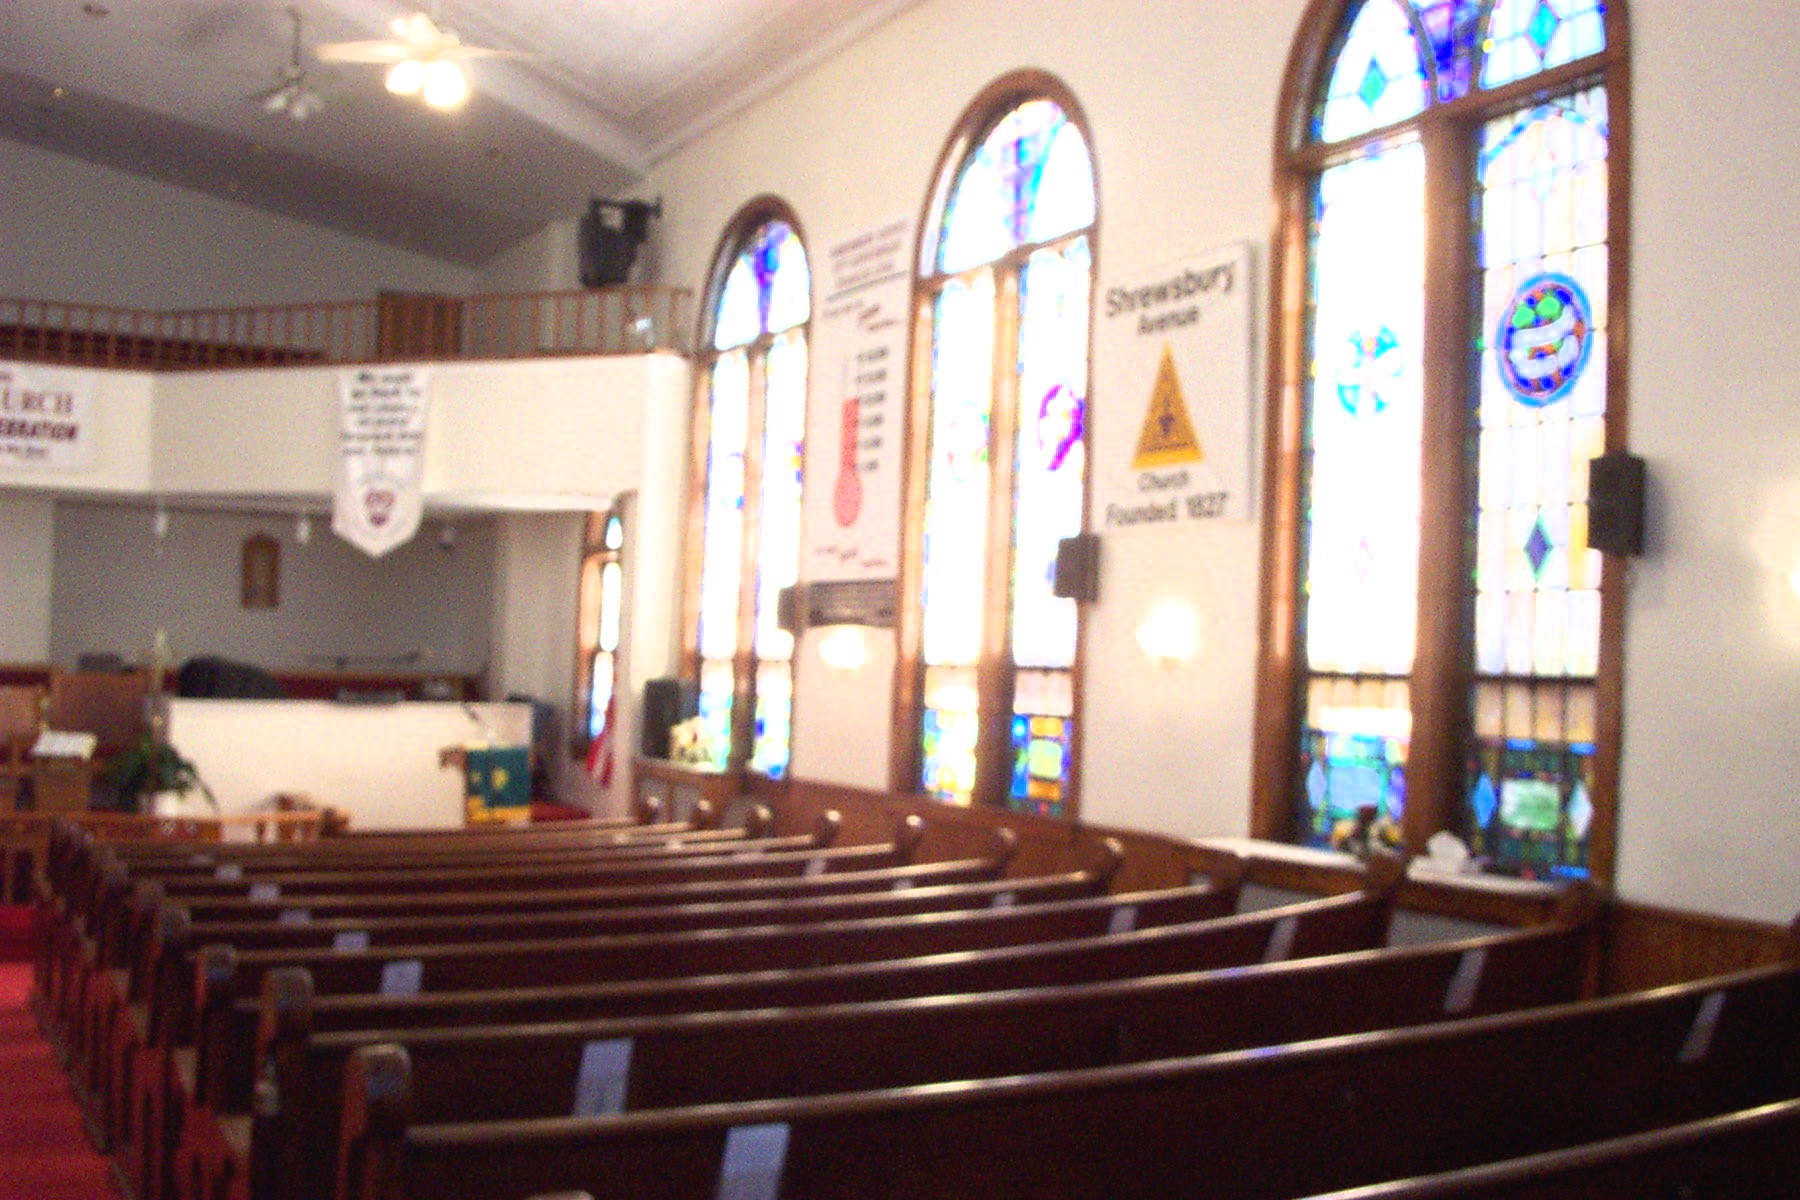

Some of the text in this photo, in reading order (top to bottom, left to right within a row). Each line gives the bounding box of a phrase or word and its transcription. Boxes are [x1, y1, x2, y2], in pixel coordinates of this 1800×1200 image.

[1105, 259, 1237, 319] Shrewsbury
[1137, 304, 1199, 336] Avenue
[1138, 470, 1189, 493] Church
[1105, 491, 1228, 527] Founded 1827
